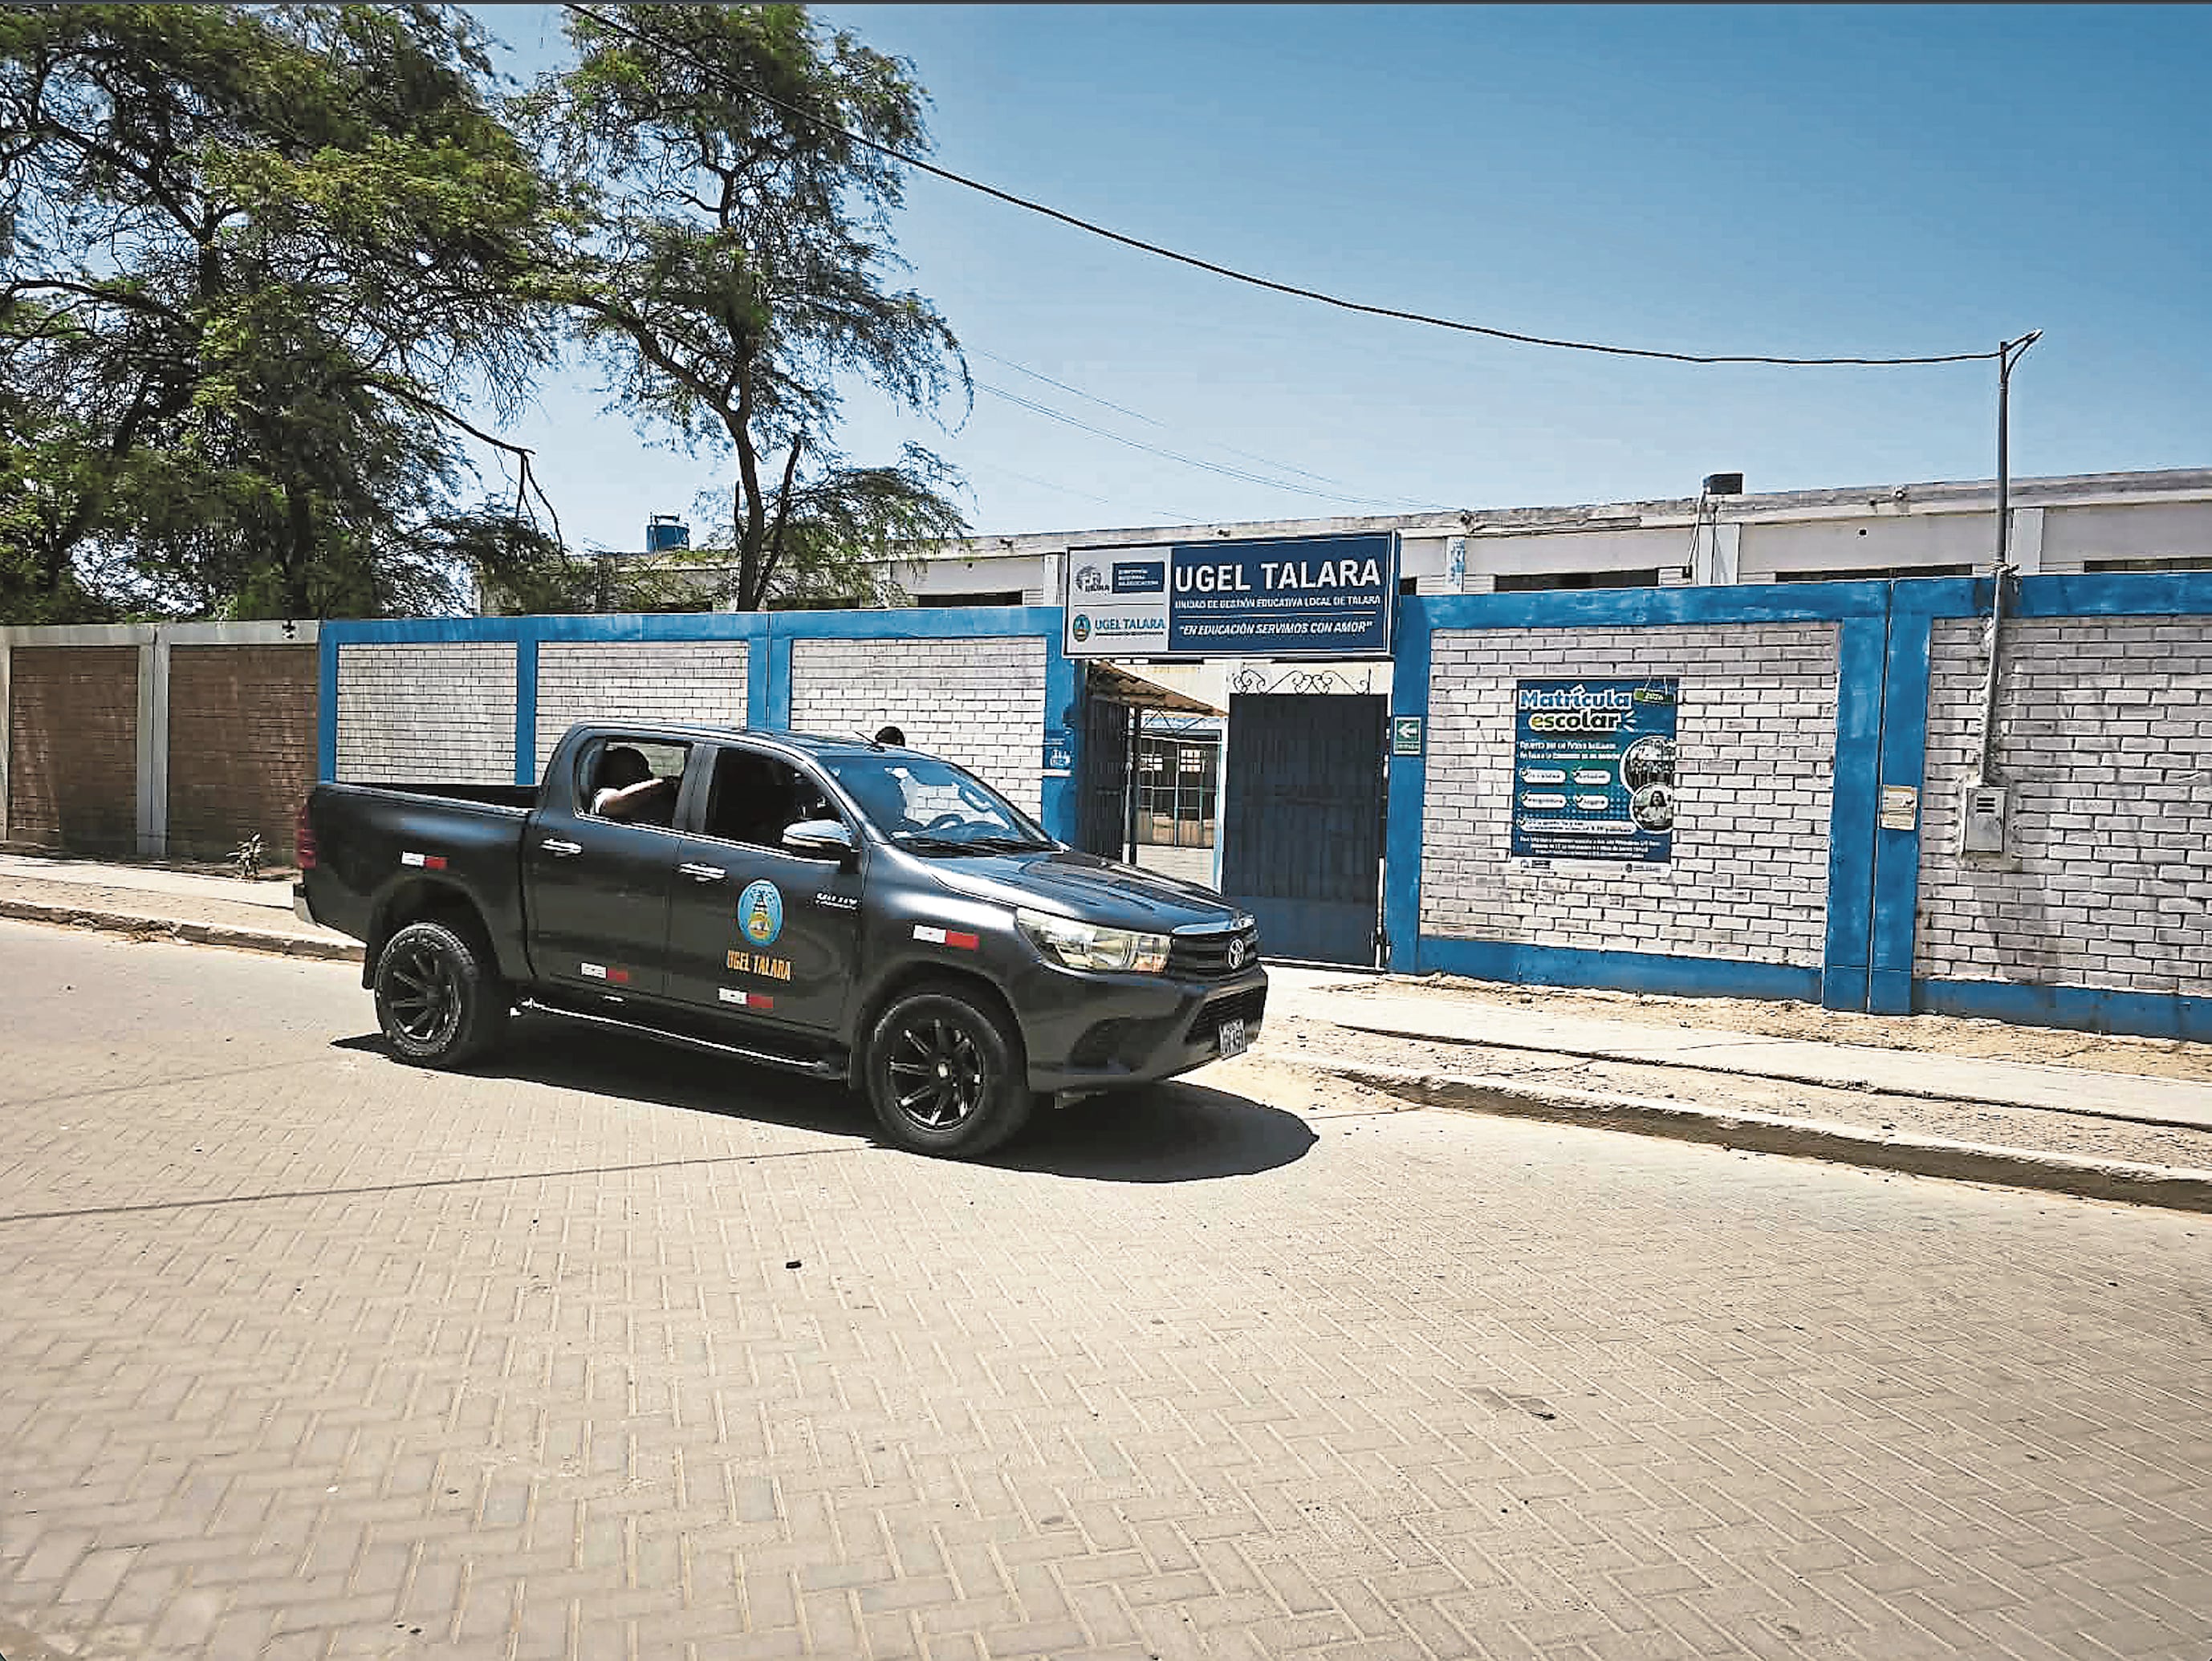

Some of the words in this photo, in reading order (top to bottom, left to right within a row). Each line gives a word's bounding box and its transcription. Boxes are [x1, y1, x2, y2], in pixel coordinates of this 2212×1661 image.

[1175, 563, 1251, 592] UGEL
[1260, 558, 1381, 590] TALARA
[1256, 597, 1303, 608] EDUCATIVA
[1304, 596, 1332, 607] LOCAL
[1332, 595, 1347, 606] DE
[1348, 595, 1380, 606] TALARA
[1095, 618, 1121, 630] UGEL
[1123, 617, 1165, 629] TALARA
[1254, 622, 1310, 635] SERVIMOS
[1310, 622, 1333, 634] CON
[1519, 684, 1633, 709] Matrícula
[1530, 709, 1621, 731] escolar
[727, 949, 750, 972] UGEL
[752, 954, 791, 981] TALARA
